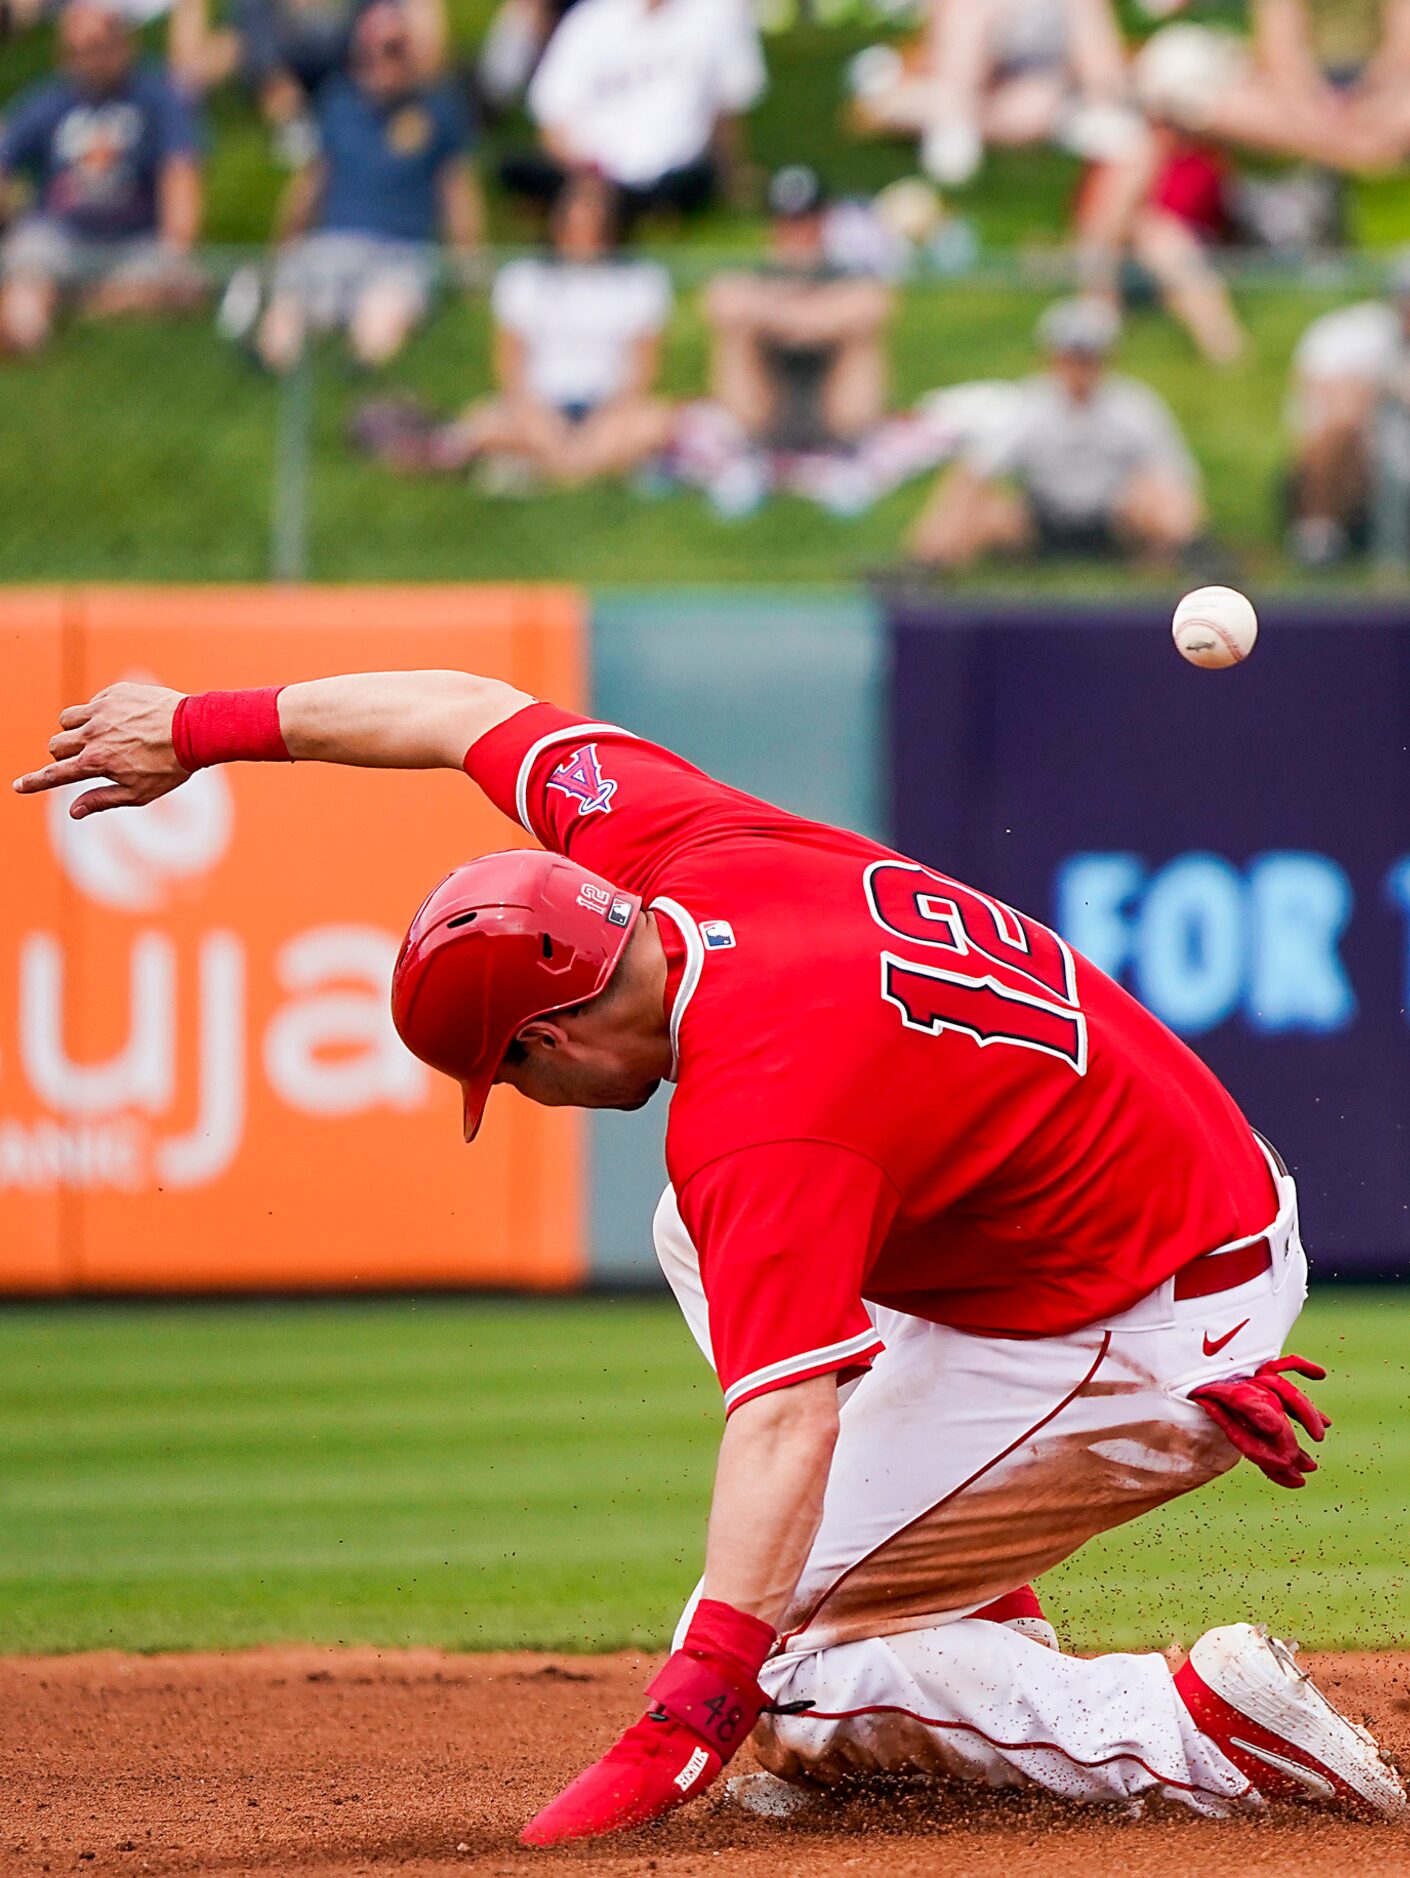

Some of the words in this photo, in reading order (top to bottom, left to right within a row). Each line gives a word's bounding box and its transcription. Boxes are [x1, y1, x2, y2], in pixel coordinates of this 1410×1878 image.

[576, 883, 611, 917] 12
[1055, 850, 1355, 1034] FOR
[862, 859, 1089, 1078] 12
[703, 1694, 744, 1743] 48
